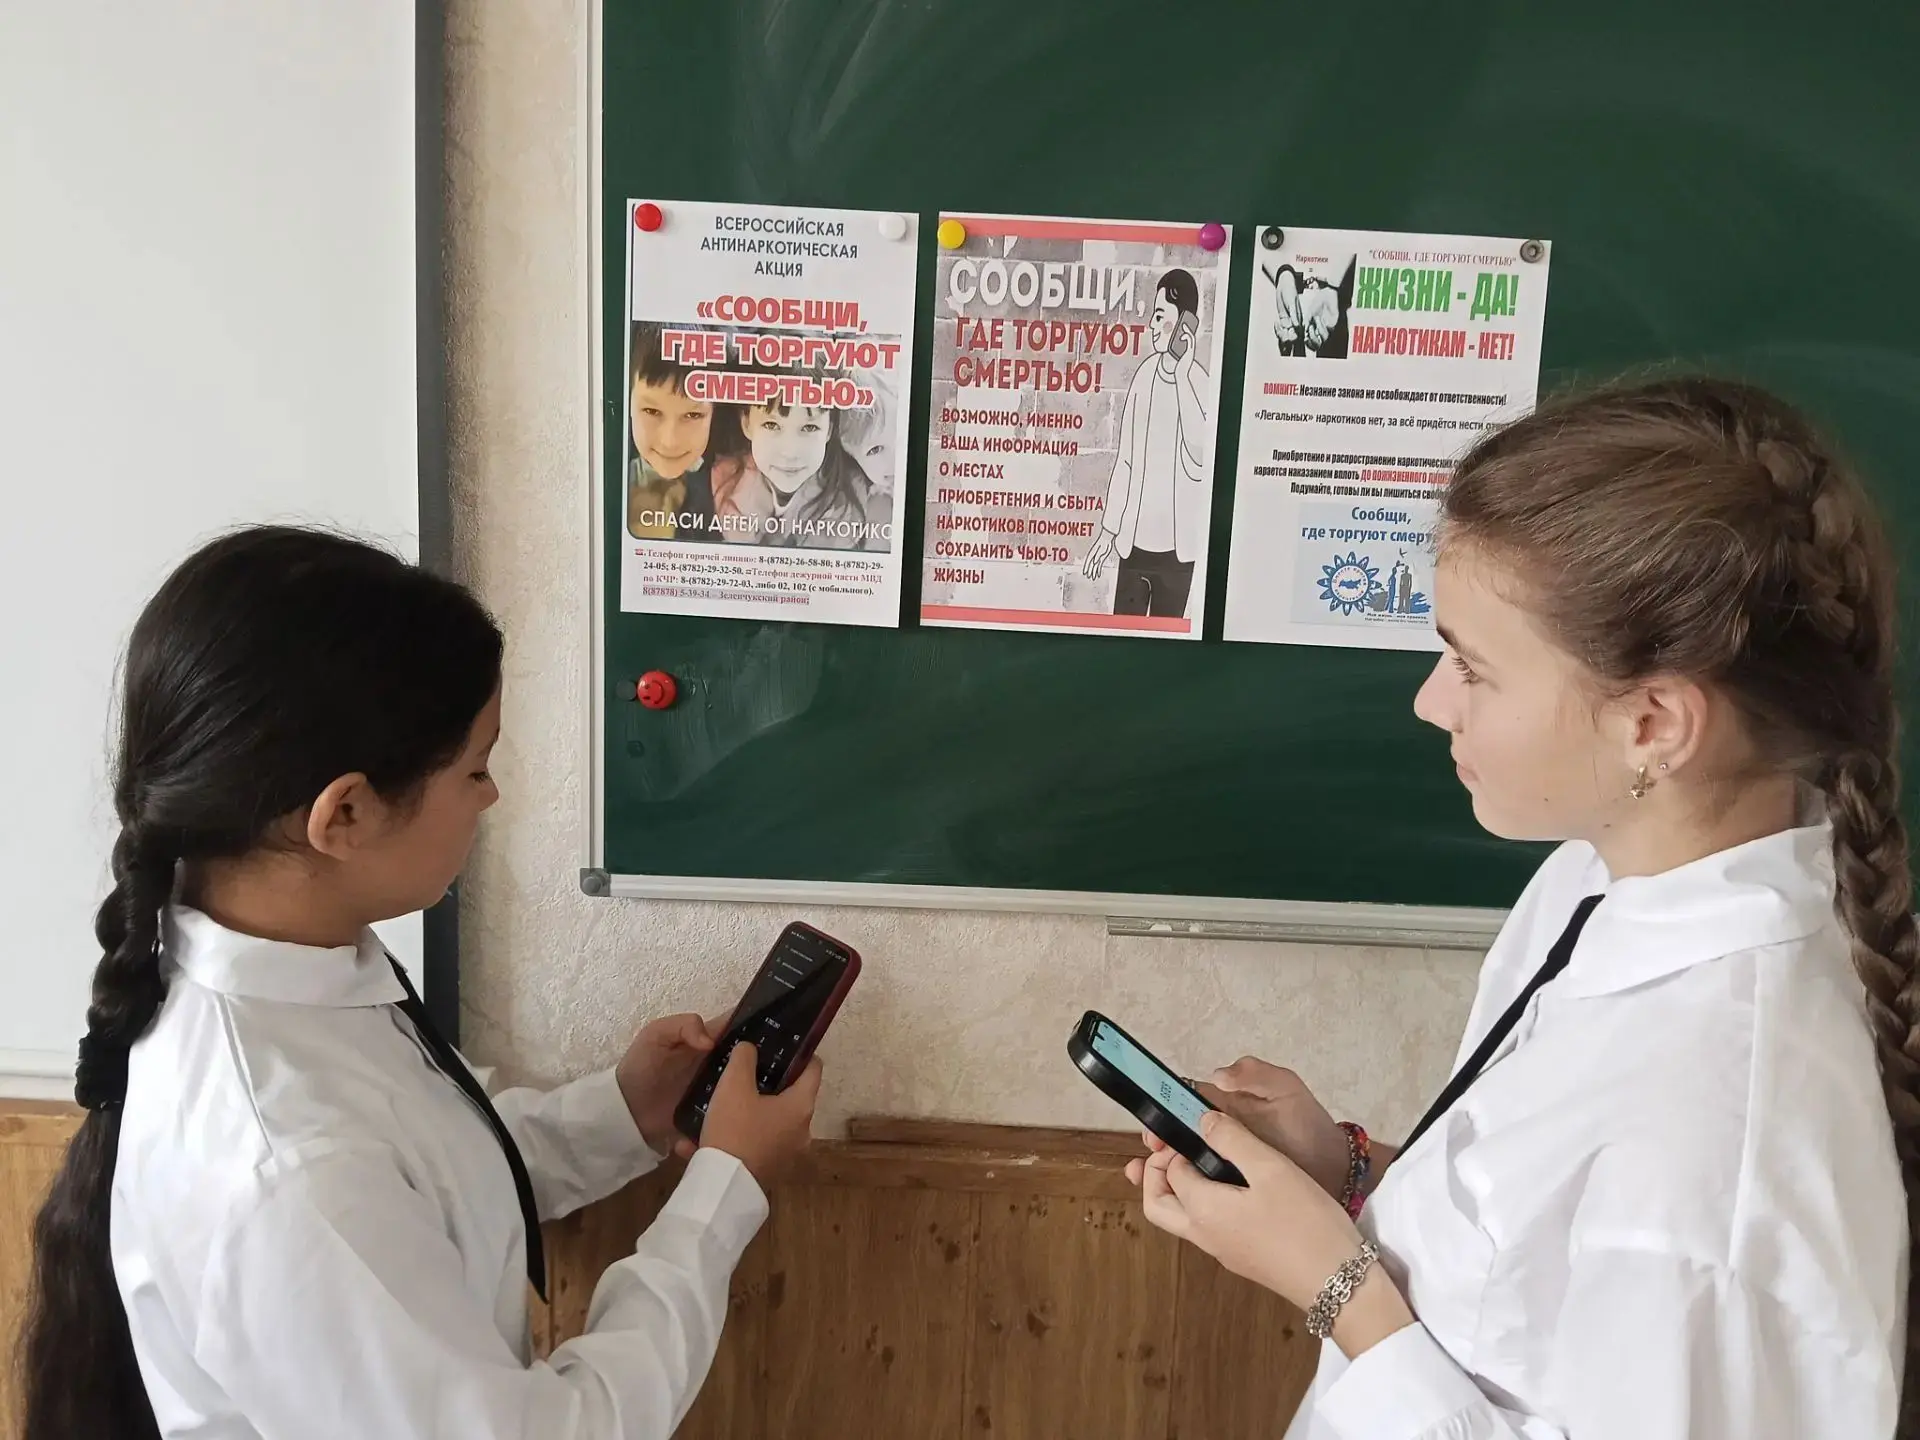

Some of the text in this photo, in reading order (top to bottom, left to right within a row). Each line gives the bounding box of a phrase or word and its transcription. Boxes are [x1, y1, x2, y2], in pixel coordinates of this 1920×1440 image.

[715, 216, 844, 237] ВСЕРОССИЙСКАЯ
[700, 237, 858, 258] АНТИНАРКОТИЧЕСКАЯ
[1414, 251, 1429, 262] ГДЕ
[1432, 253, 1471, 264] ТОРГУЮТ
[754, 261, 803, 277] АКЦИЯ
[1296, 254, 1328, 263] Наркотики
[950, 259, 1145, 317] СООБЩИ,
[1356, 267, 1452, 312] ЖИЗНИ
[1470, 273, 1519, 321] ДА!
[697, 295, 867, 332] «СООБЩИ,
[956, 317, 1145, 355] ГДЕ ТОРГУЮТ
[1352, 326, 1466, 358] НАРКОТИКАМ
[1478, 332, 1514, 360] НЕТ!
[663, 331, 900, 369] ГДЕ ТОРГУЮТ
[954, 357, 1101, 393] СМЕРТЬЮ!
[686, 373, 874, 407] СМЕРТЬЮ»
[1263, 383, 1507, 405] ПОМНИТЕ: Незнание закона не освобождает от ответственности!
[942, 408, 1083, 429] ВОЗМОЖНО, ИМЕННО
[1255, 410, 1313, 422] «Легальных»
[1316, 414, 1366, 425] наркотиков
[1369, 417, 1385, 428] нет,
[1387, 418, 1397, 426] за
[1400, 416, 1414, 427] всё
[1416, 417, 1456, 430] придётся
[1459, 421, 1483, 430] нести
[941, 435, 1078, 456] ВАША ИНФОРМАЦИЯ
[1273, 450, 1324, 463] Приобретение
[1326, 453, 1330, 461] и
[1332, 453, 1395, 465] распространение
[939, 461, 1004, 479] О МЕСТАХ
[1254, 466, 1287, 477] карается
[1288, 468, 1332, 479] наказанием
[1334, 470, 1359, 480] вплоть
[938, 488, 1104, 511] ПРИОБРЕТЕНИЯ И СБЫТА
[1291, 482, 1332, 496] Подумайте,
[1333, 485, 1359, 496] готовы
[1360, 487, 1370, 497] ли
[1371, 487, 1382, 498] вы
[1384, 489, 1421, 499] лишиться
[640, 510, 704, 529] СПАСИ
[708, 512, 758, 532] ДЕТЕЙ
[764, 517, 787, 534] ОТ
[937, 515, 1094, 537] НАРКОТИКОВ ПОМОЖЕТ
[1352, 507, 1411, 525] Сообщи,
[1302, 527, 1433, 546] где торгуют смерт
[935, 541, 1068, 562] СОХРАНИТЬ ЧЬЮ-ТО
[643, 562, 669, 571] 24-05;
[835, 574, 859, 582] части
[933, 568, 984, 584] ЖИЗНЬ!
[755, 581, 776, 589] либо
[778, 582, 790, 591] 02,
[793, 582, 806, 591] 102
[808, 583, 816, 593] (с
